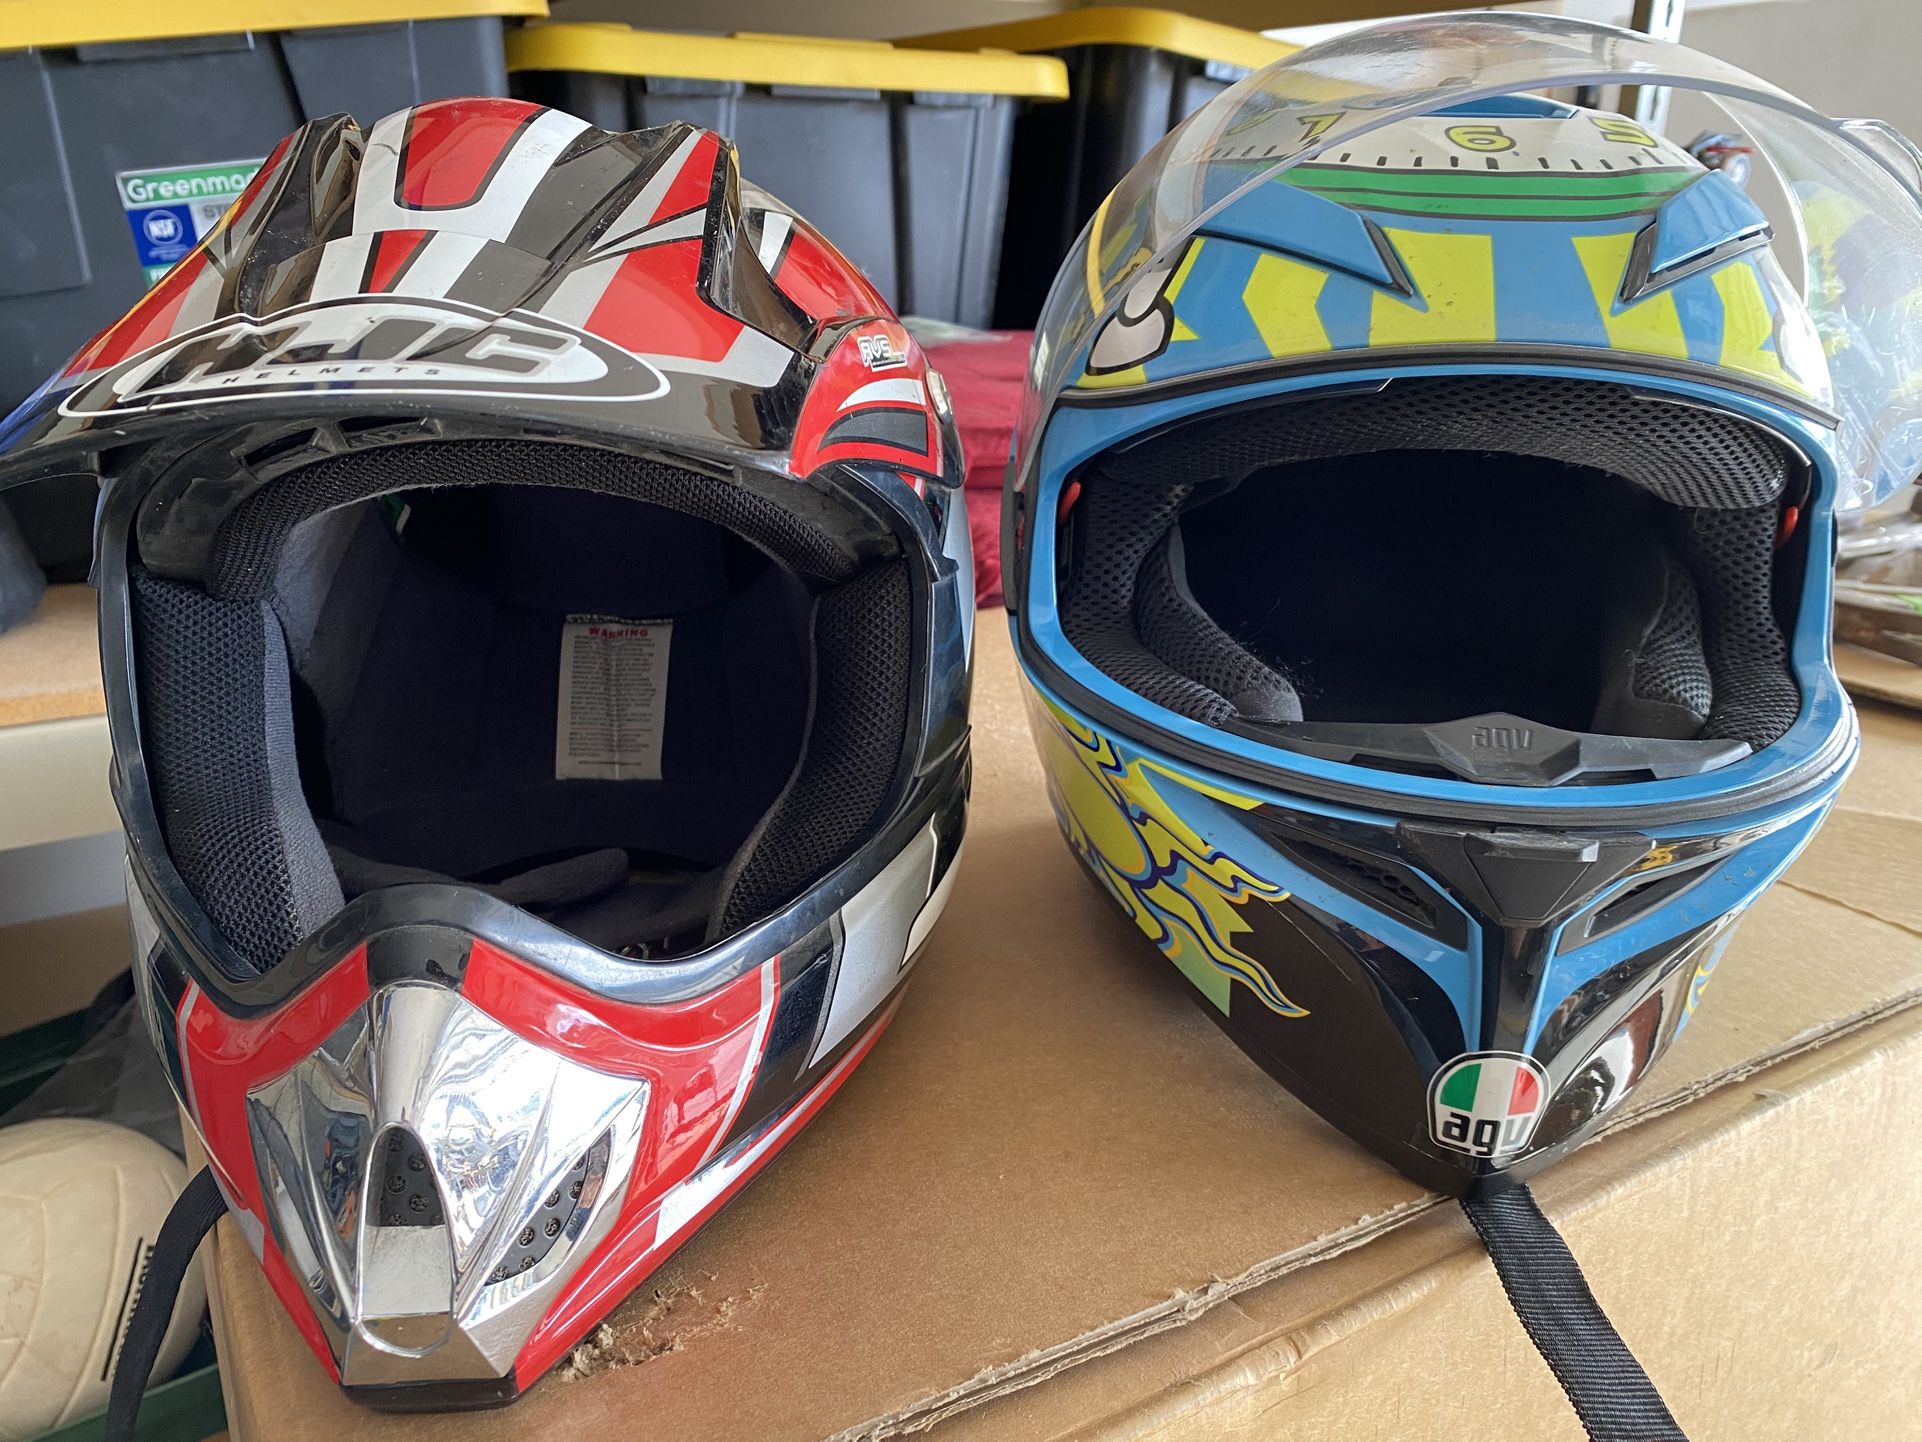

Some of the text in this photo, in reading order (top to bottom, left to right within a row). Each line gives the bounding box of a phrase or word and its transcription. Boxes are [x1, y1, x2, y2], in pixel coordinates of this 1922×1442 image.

[1444, 124, 1516, 153] 6
[122, 317, 581, 397] HJC
[222, 366, 440, 385] HELMETS
[588, 626, 648, 639] WARNING
[1472, 726, 1533, 759] agv
[1442, 1111, 1532, 1157] agv
